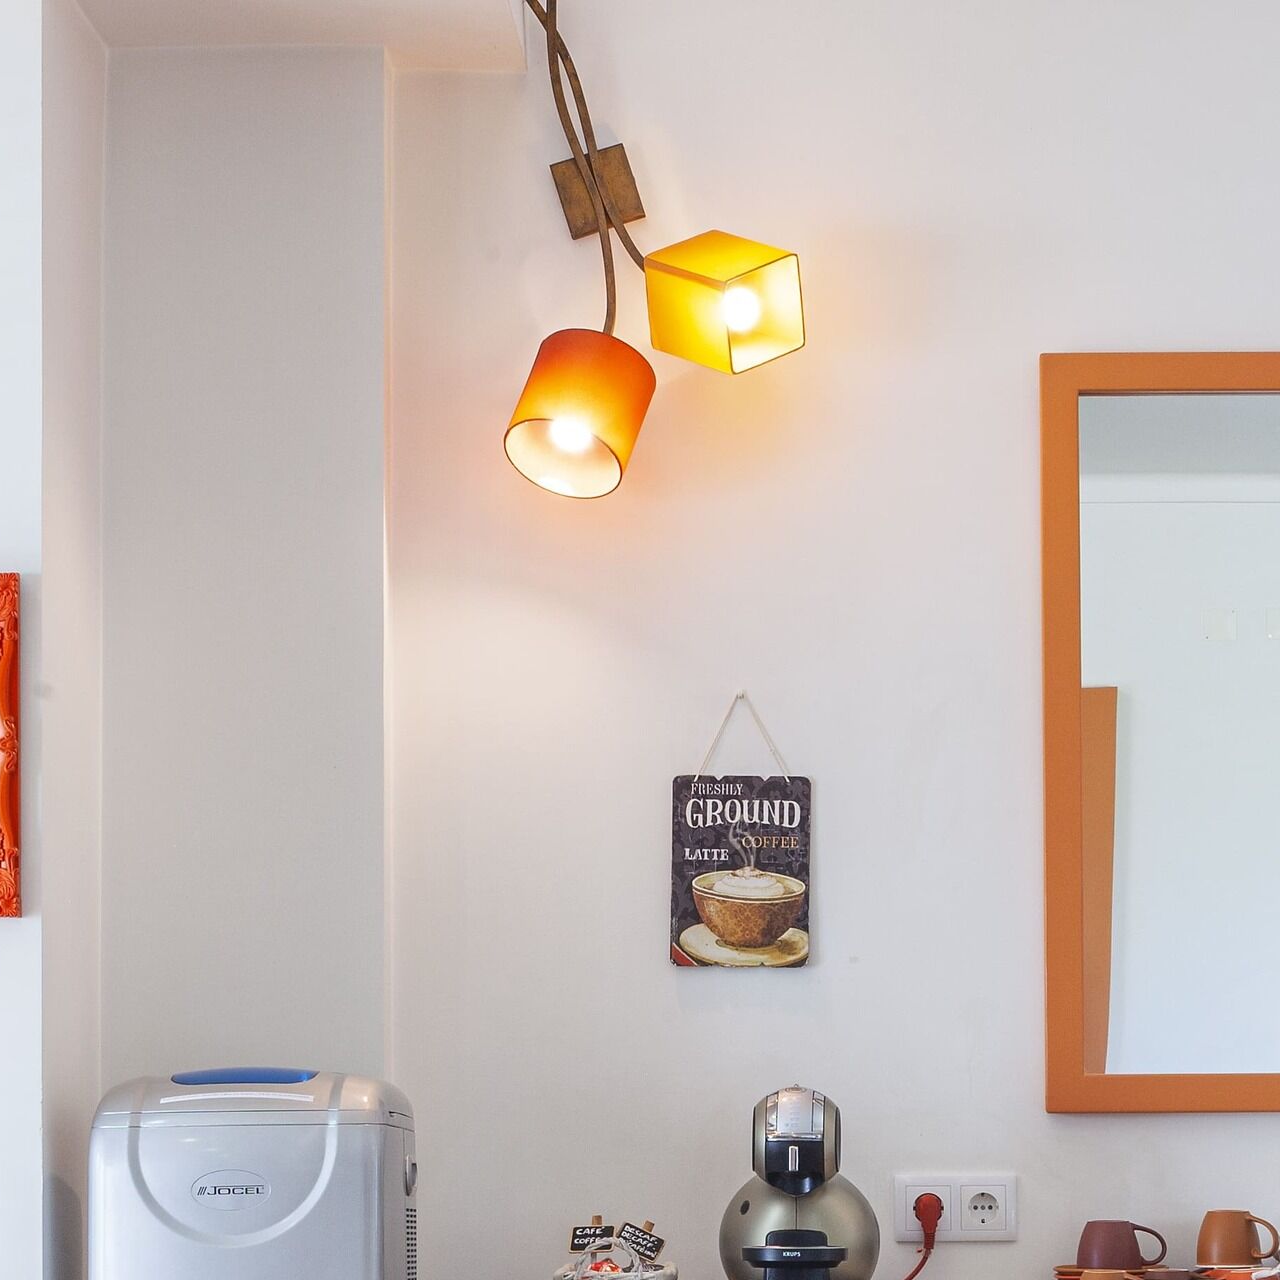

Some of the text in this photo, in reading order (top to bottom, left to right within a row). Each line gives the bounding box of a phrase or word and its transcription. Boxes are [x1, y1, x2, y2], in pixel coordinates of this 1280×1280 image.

[690, 783, 744, 796] FRESHLY
[685, 798, 802, 829] GROUND
[741, 835, 800, 849] COFFEE
[683, 847, 730, 862] LATTE
[207, 1185, 265, 1196] JOCEL
[575, 1226, 605, 1236] CAFÉ
